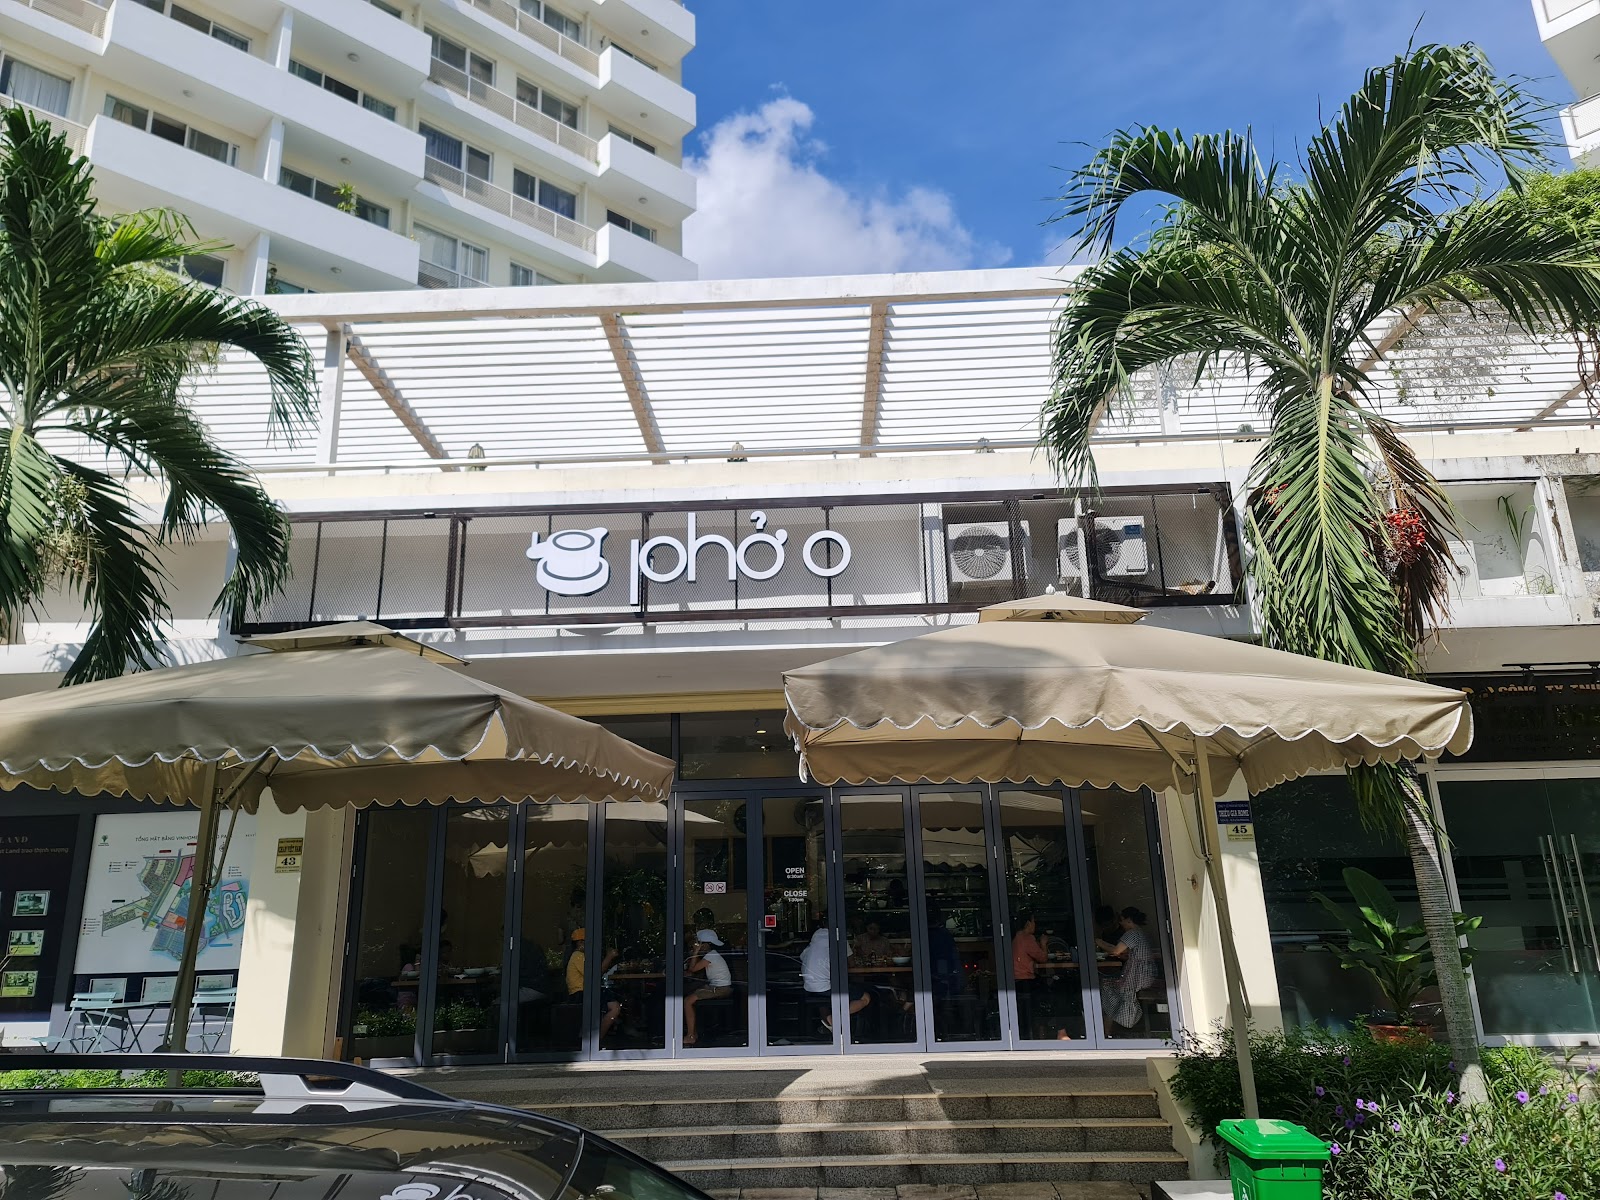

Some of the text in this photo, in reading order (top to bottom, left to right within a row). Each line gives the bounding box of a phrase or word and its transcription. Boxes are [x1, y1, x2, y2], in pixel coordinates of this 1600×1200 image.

[630, 510, 852, 606] phở o
[1232, 825, 1248, 834] 45
[281, 857, 296, 866] 43
